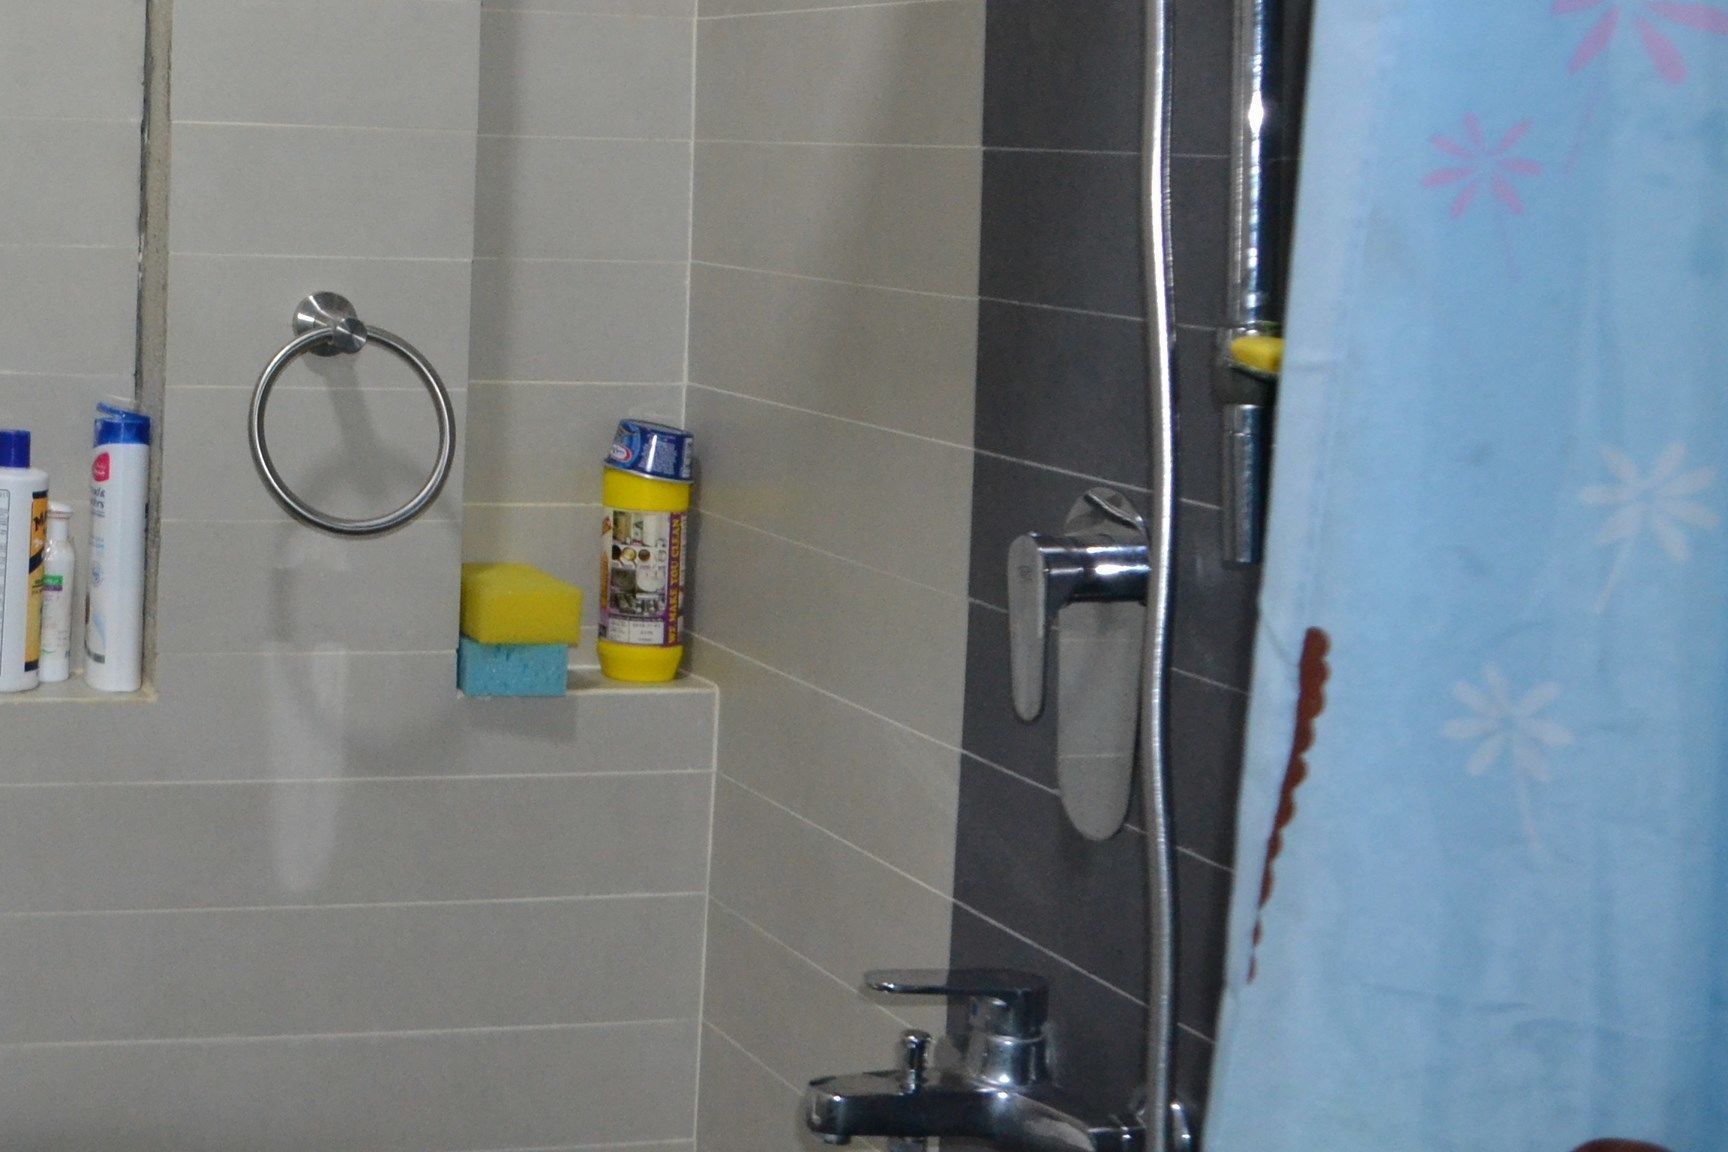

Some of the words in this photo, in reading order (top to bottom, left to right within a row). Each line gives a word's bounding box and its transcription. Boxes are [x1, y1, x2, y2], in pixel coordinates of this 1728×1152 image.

[670, 519, 681, 558] CLEAN
[670, 560, 680, 586] YOU
[669, 587, 679, 623] MAKE
